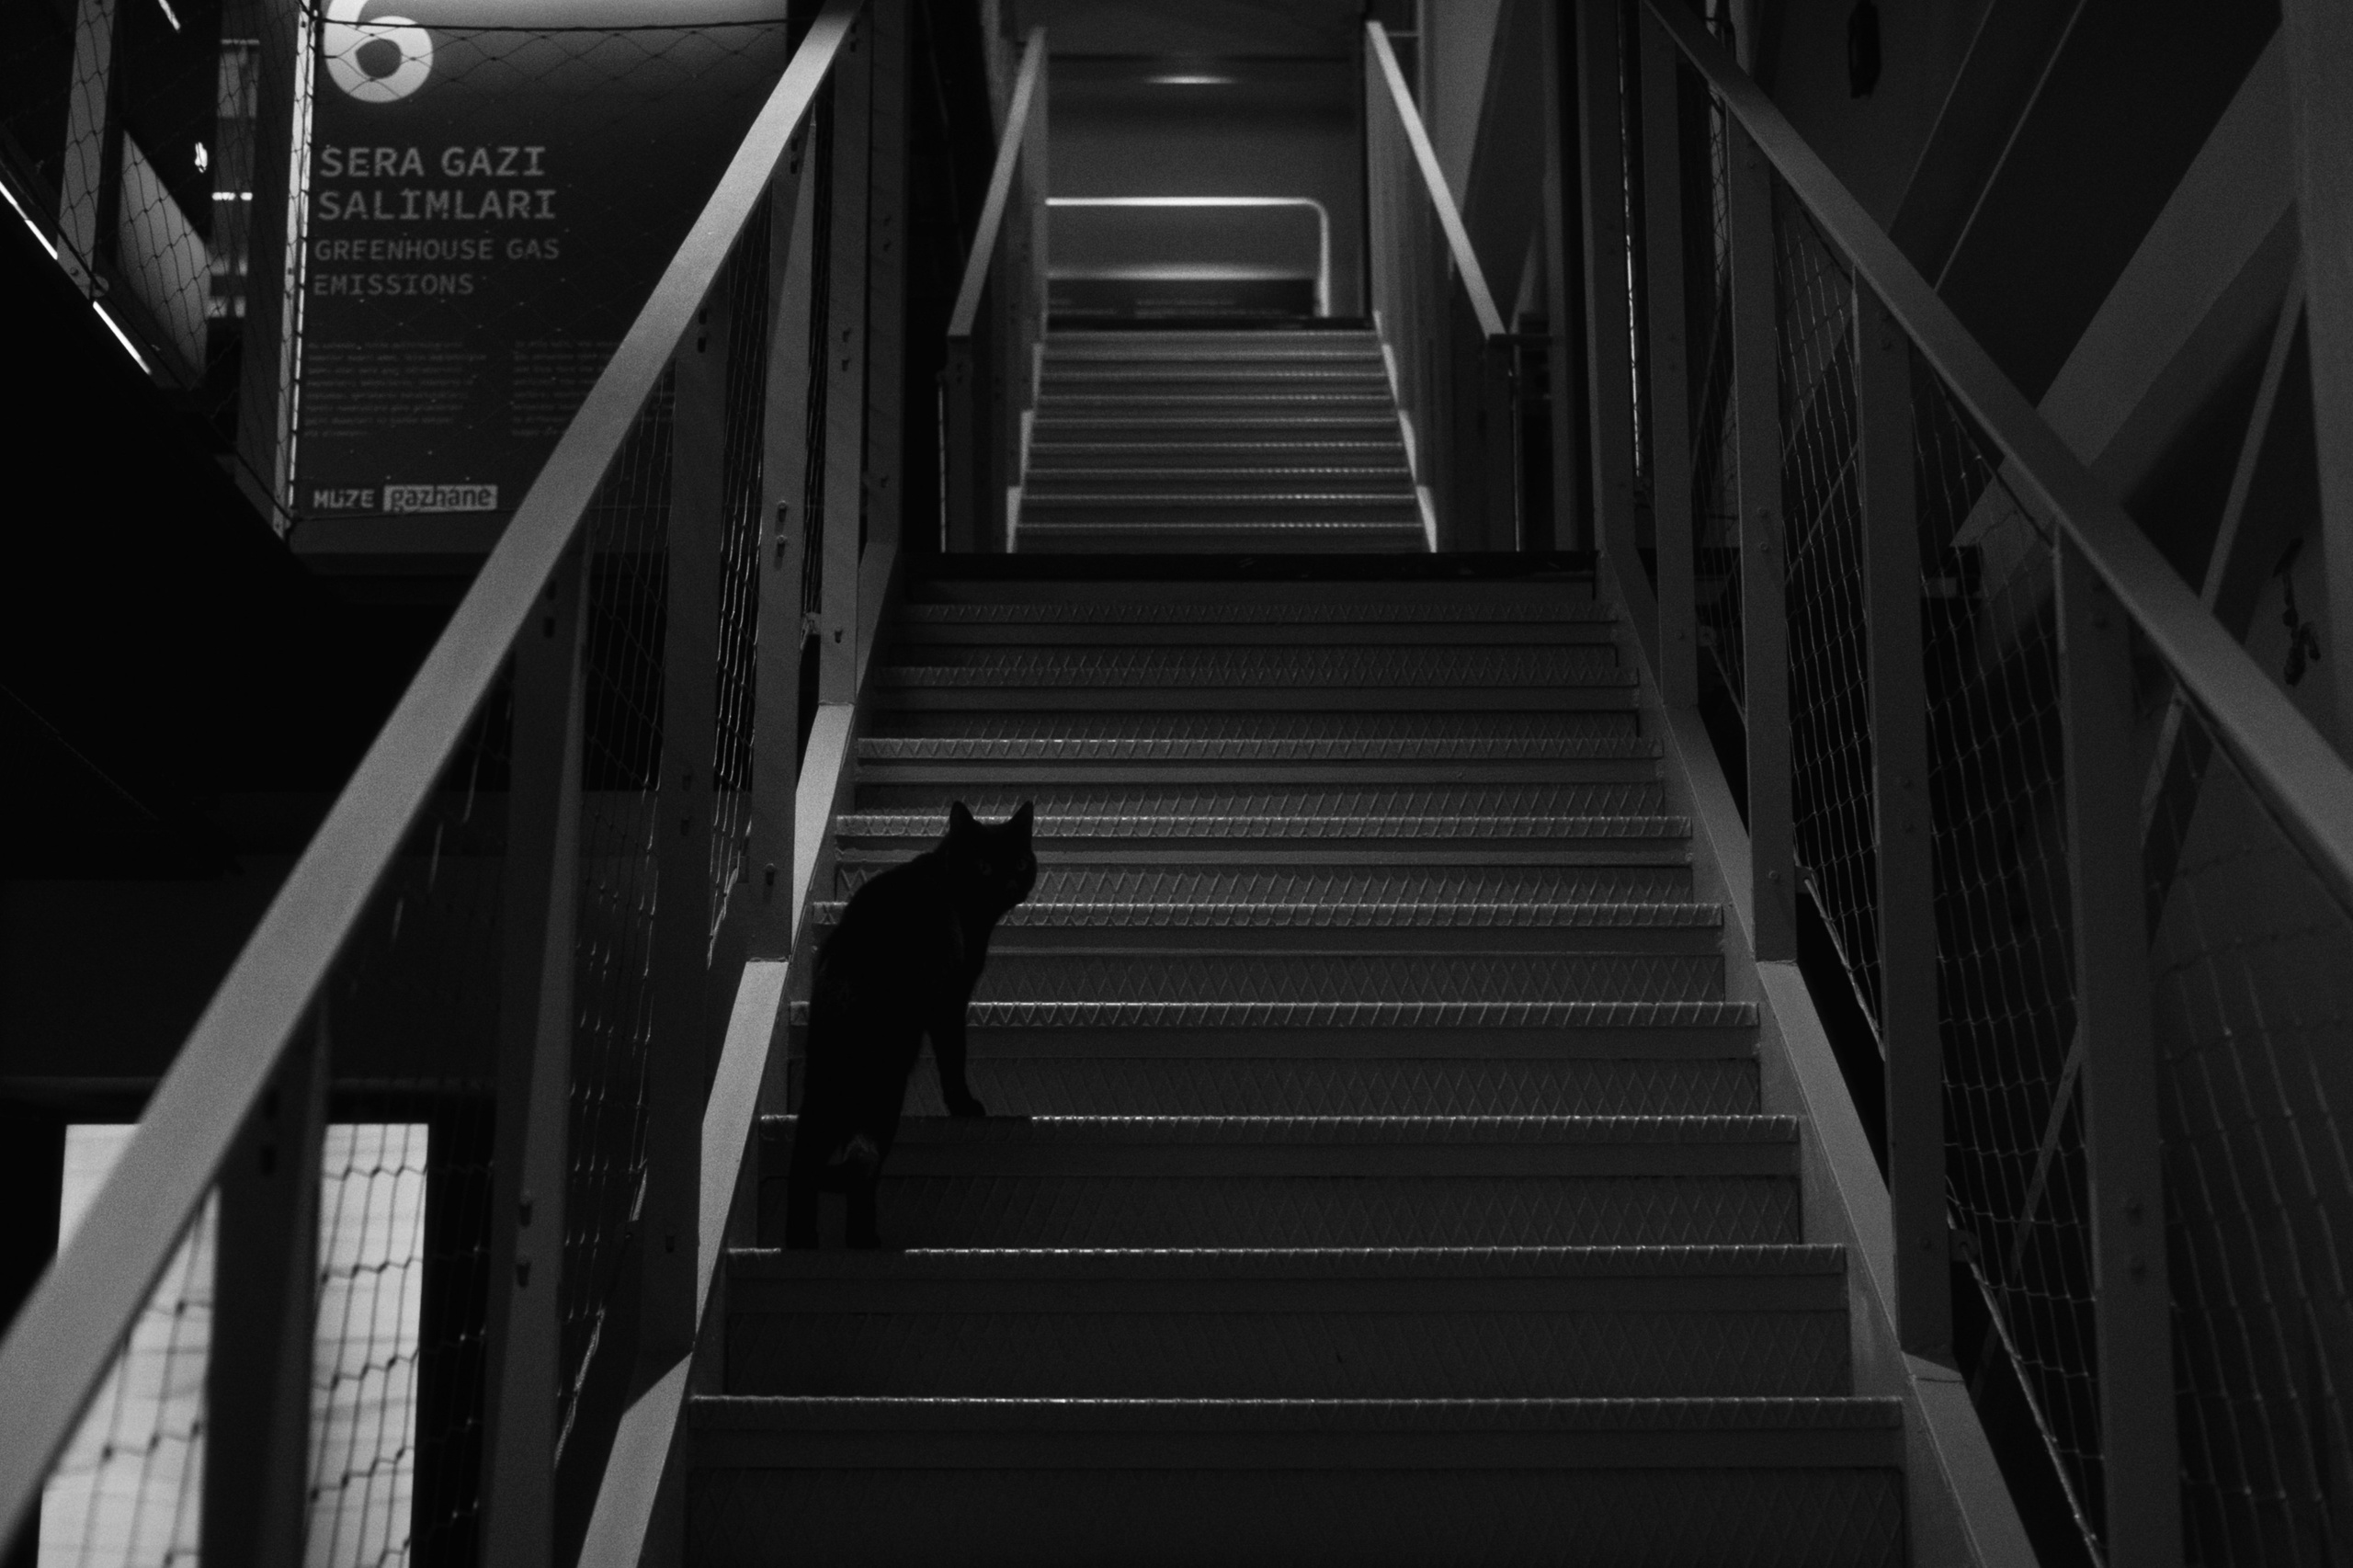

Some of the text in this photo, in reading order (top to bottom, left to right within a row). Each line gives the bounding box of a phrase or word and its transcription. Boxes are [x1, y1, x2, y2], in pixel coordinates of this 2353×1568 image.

[323, 0, 433, 103] 6
[320, 145, 546, 177] SERA GAZI
[318, 189, 558, 221] SALIMLARI
[314, 238, 561, 261] GREENHOUSE GAS
[313, 273, 475, 296] EMISSIONS
[391, 484, 493, 512] gazhane
